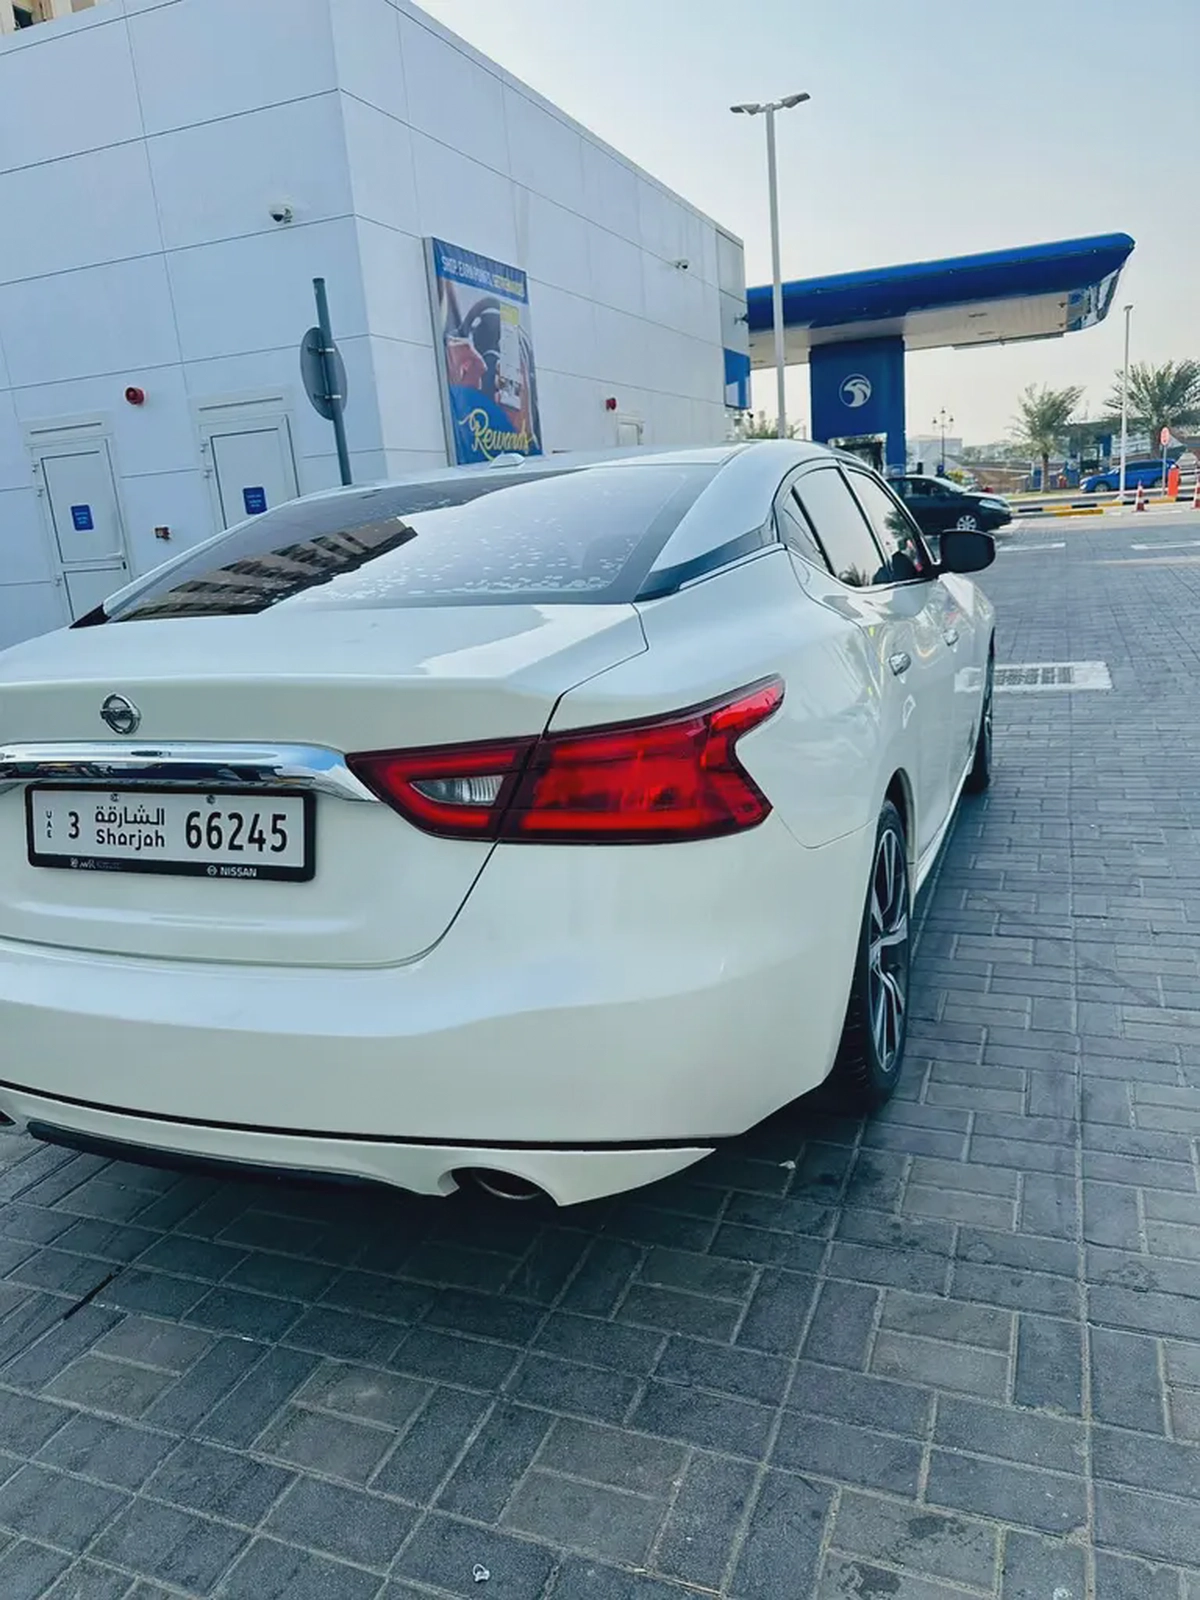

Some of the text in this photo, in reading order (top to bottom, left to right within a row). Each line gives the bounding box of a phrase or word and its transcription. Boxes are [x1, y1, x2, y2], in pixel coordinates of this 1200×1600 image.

[459, 408, 534, 461] Rewards
[68, 811, 80, 839] 3
[95, 804, 165, 828] الشارقة
[96, 828, 165, 850] Sharjah
[185, 811, 287, 852] 66245
[220, 866, 257, 877] NISSAN
